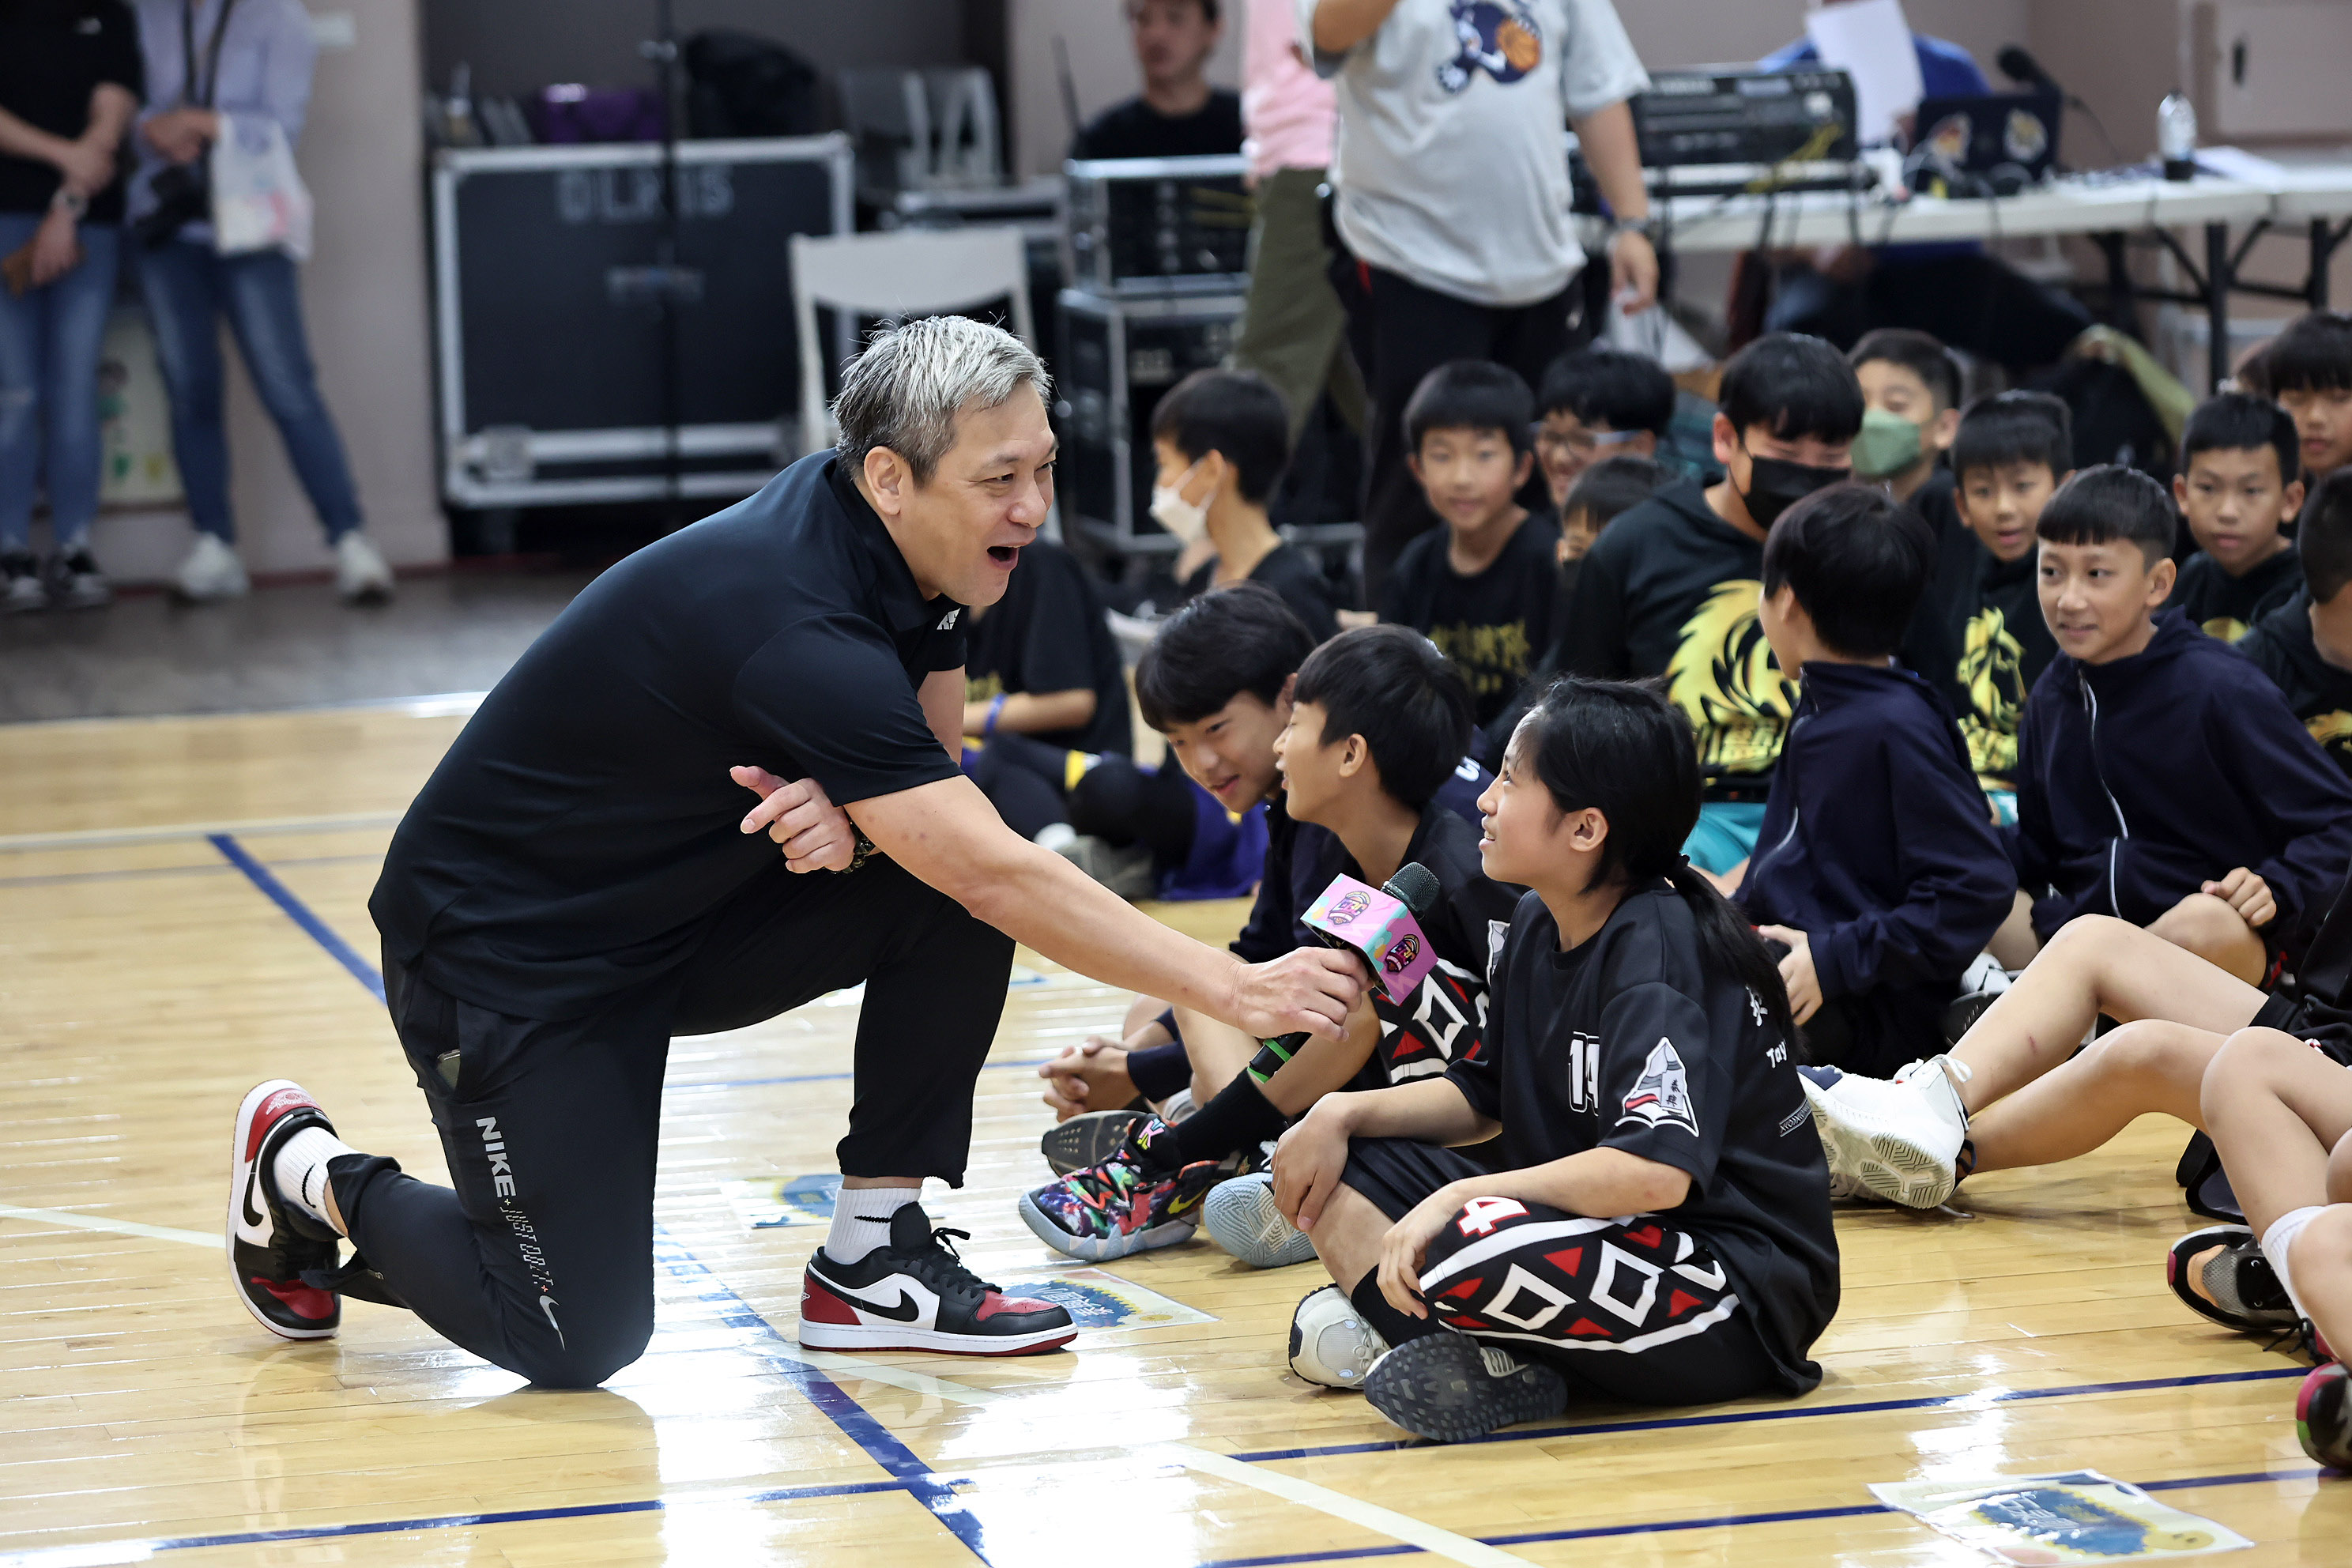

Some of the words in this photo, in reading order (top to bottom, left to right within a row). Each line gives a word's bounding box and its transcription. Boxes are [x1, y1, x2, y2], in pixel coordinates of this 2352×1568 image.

[476, 1116, 517, 1198] NIKE
[499, 1206, 537, 1242] JUST
[519, 1242, 546, 1266] DO
[1457, 1195, 1531, 1237] 4
